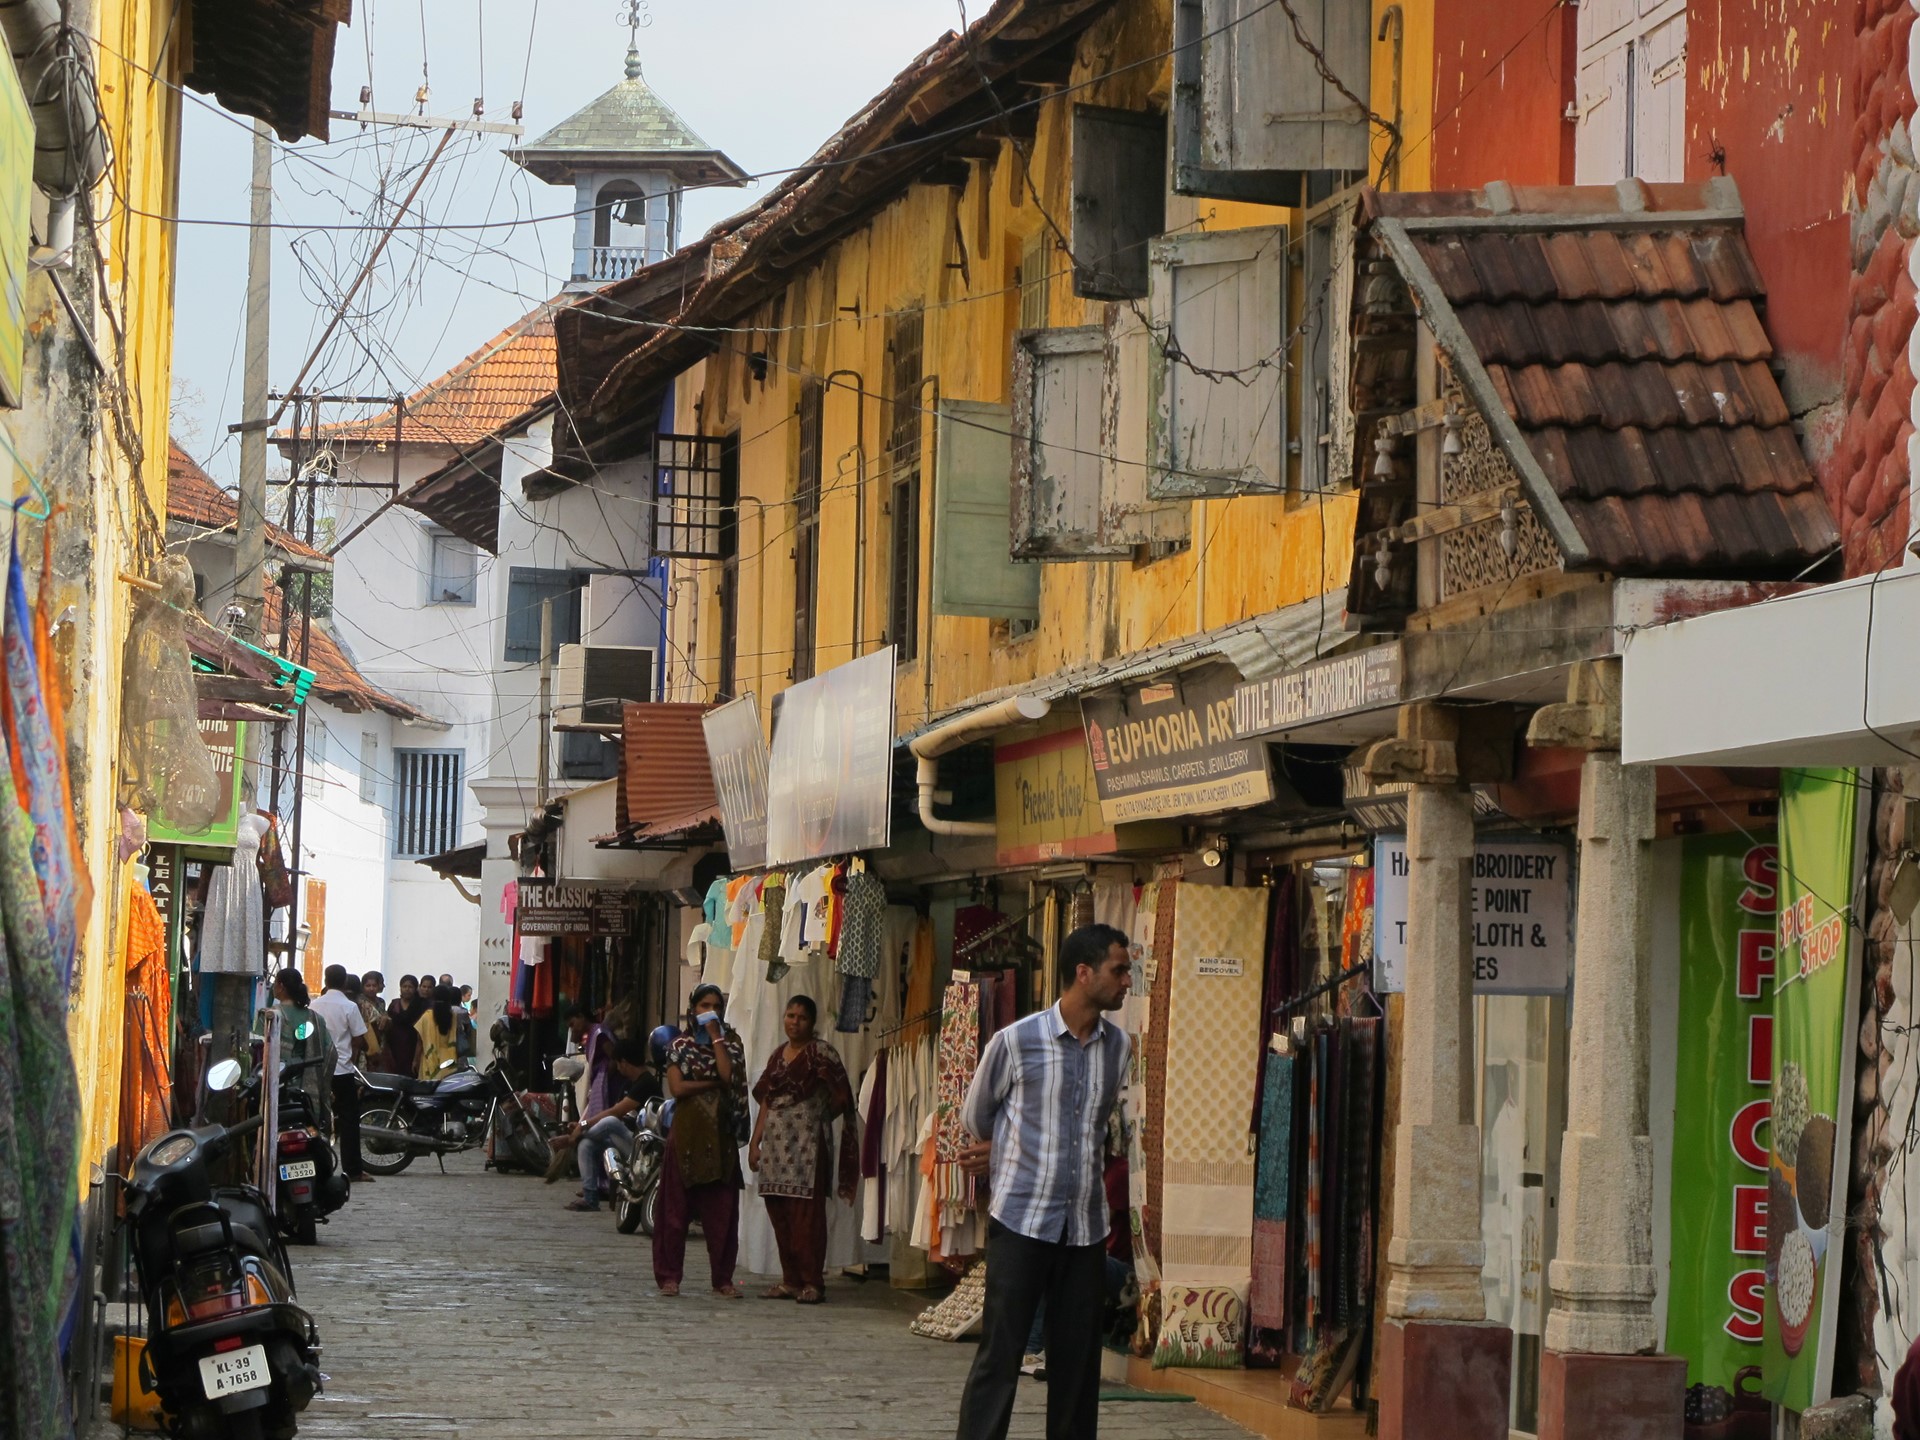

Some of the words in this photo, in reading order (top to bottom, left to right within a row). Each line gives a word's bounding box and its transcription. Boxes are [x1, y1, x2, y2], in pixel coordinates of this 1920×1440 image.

[1235, 681, 1270, 734] LITTLE
[1272, 672, 1303, 725] QUEEN
[1305, 654, 1367, 718] EMBROIDERY
[1106, 708, 1204, 765] EUPHORIA
[1106, 772, 1142, 792] PASHMINA
[1472, 853, 1557, 880] BROIDERY
[520, 885, 543, 908] THE
[1485, 888, 1532, 914] POINT
[521, 923, 561, 932] GOVERNMENT
[564, 923, 573, 932] OF
[573, 923, 590, 932] INDIA
[1779, 890, 1814, 952] SPICE
[1472, 922, 1524, 947] LOTH
[1531, 923, 1547, 948] &
[1800, 915, 1842, 979] SHOP
[1199, 967, 1239, 975] BEDCOVER
[1723, 843, 1778, 1342] SPICES
